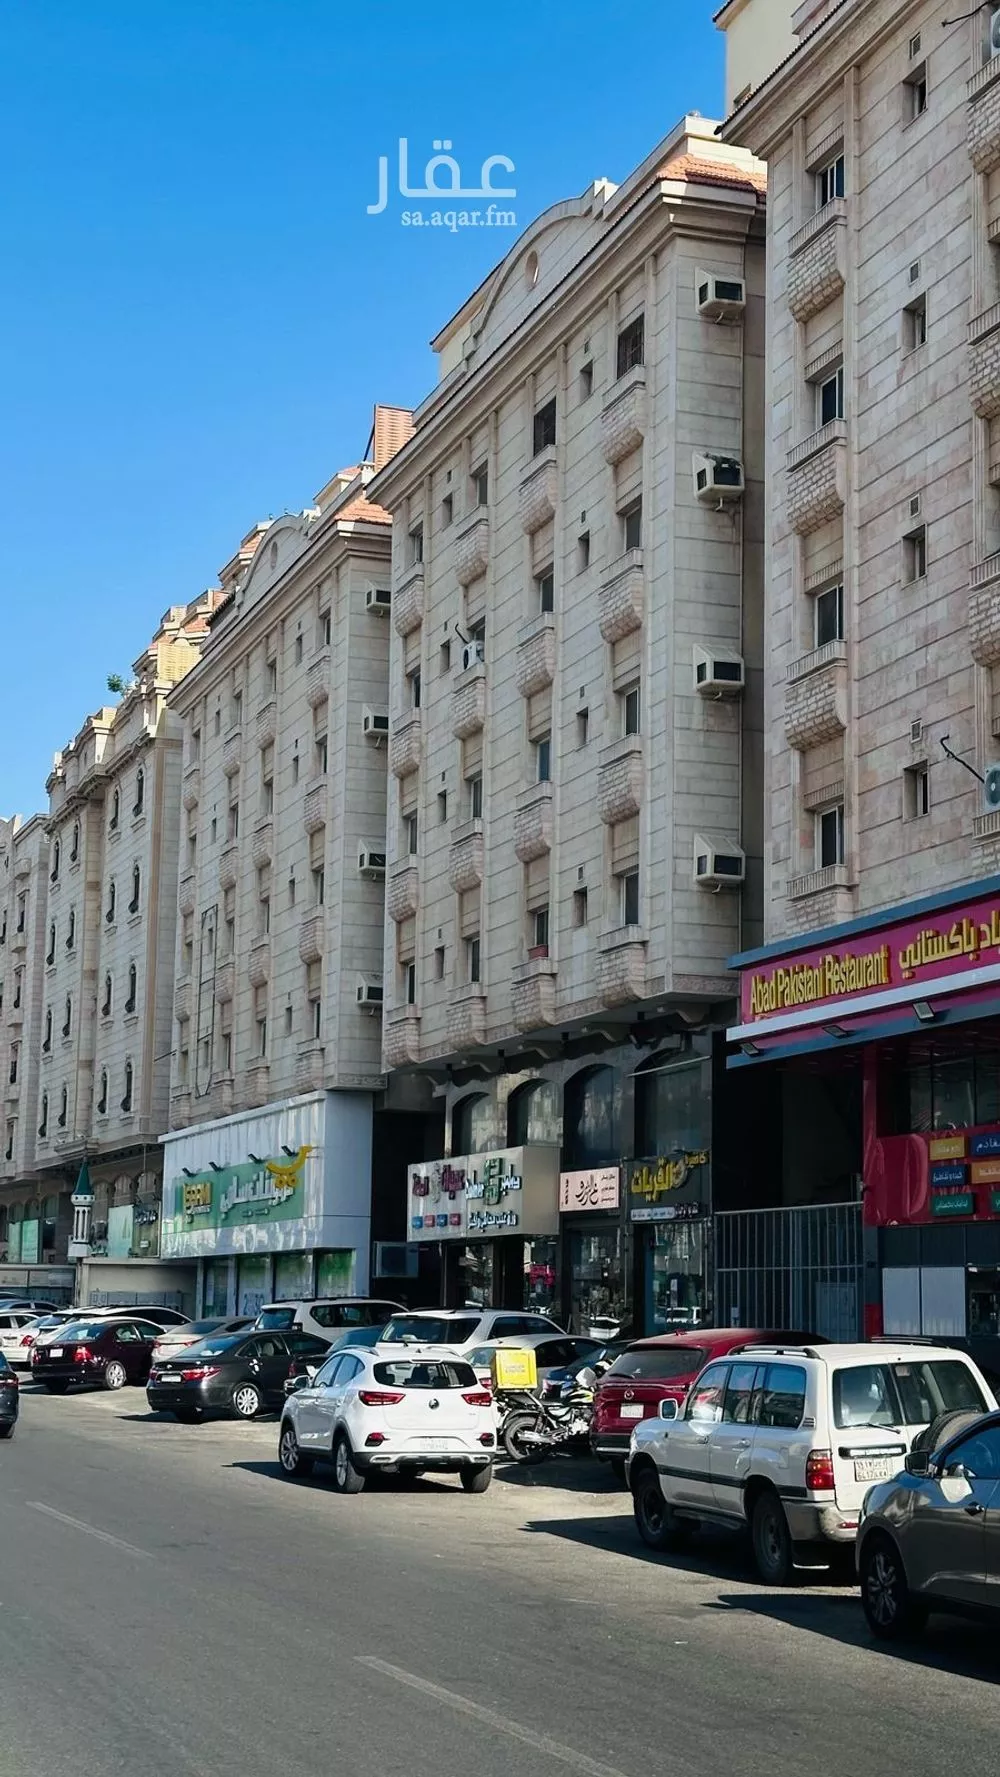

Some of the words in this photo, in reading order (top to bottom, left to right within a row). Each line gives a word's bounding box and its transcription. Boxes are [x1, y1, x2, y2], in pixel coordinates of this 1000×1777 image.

[750, 970, 778, 1015] Abad
[777, 957, 824, 1007] Pakistani
[825, 944, 889, 996] Restaurant
